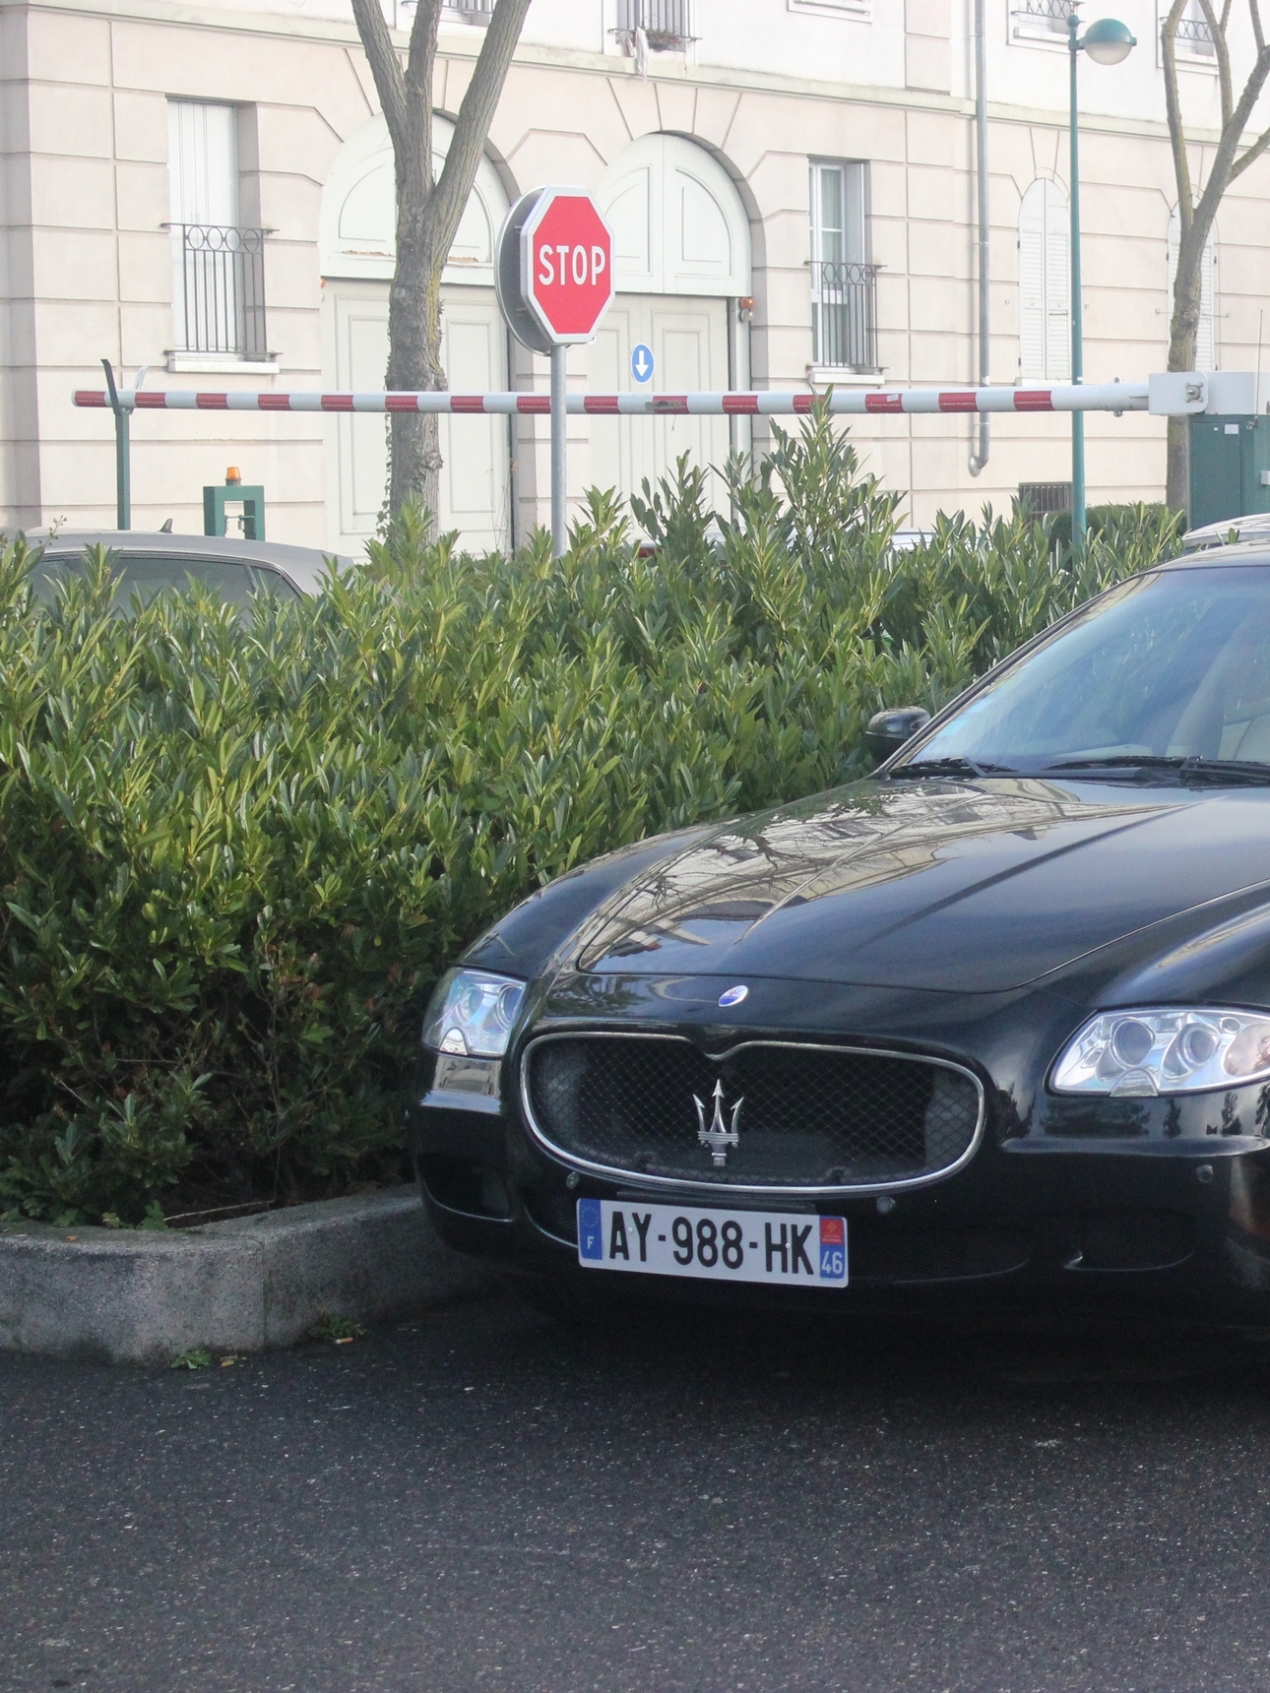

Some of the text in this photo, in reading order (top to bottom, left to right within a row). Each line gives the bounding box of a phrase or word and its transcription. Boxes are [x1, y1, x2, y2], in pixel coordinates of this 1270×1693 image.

[538, 244, 606, 286] STOP
[586, 1235, 595, 1250] F
[609, 1210, 815, 1276] AY-988-HK
[821, 1250, 844, 1275] 46
